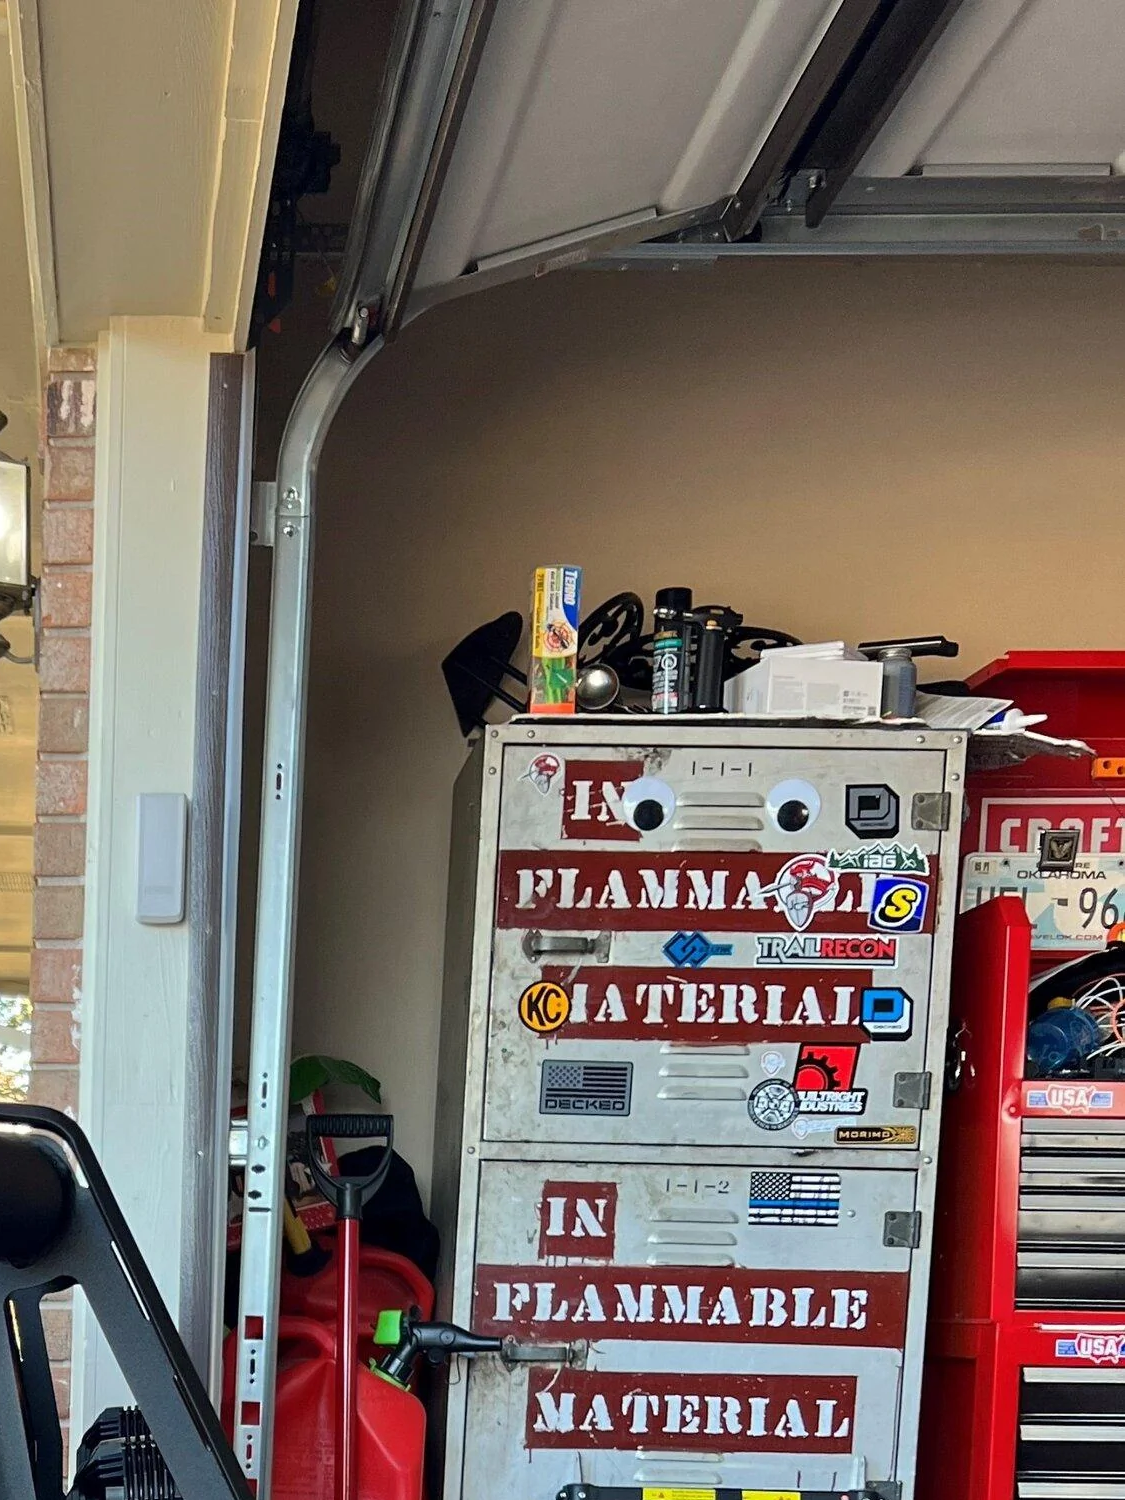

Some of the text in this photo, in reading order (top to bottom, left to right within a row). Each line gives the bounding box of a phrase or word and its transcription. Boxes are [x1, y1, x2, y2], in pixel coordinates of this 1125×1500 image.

[515, 868, 893, 913] FLAMMAL
[757, 935, 896, 959] TRAILRECON
[527, 985, 562, 1026] KC
[545, 1099, 625, 1111] DECKED
[1050, 1088, 1088, 1106] USA
[545, 1197, 608, 1238] IN
[491, 1282, 869, 1331] FLAMMABLE
[1080, 1338, 1119, 1356] USA
[533, 1391, 850, 1438] MATERIAL
